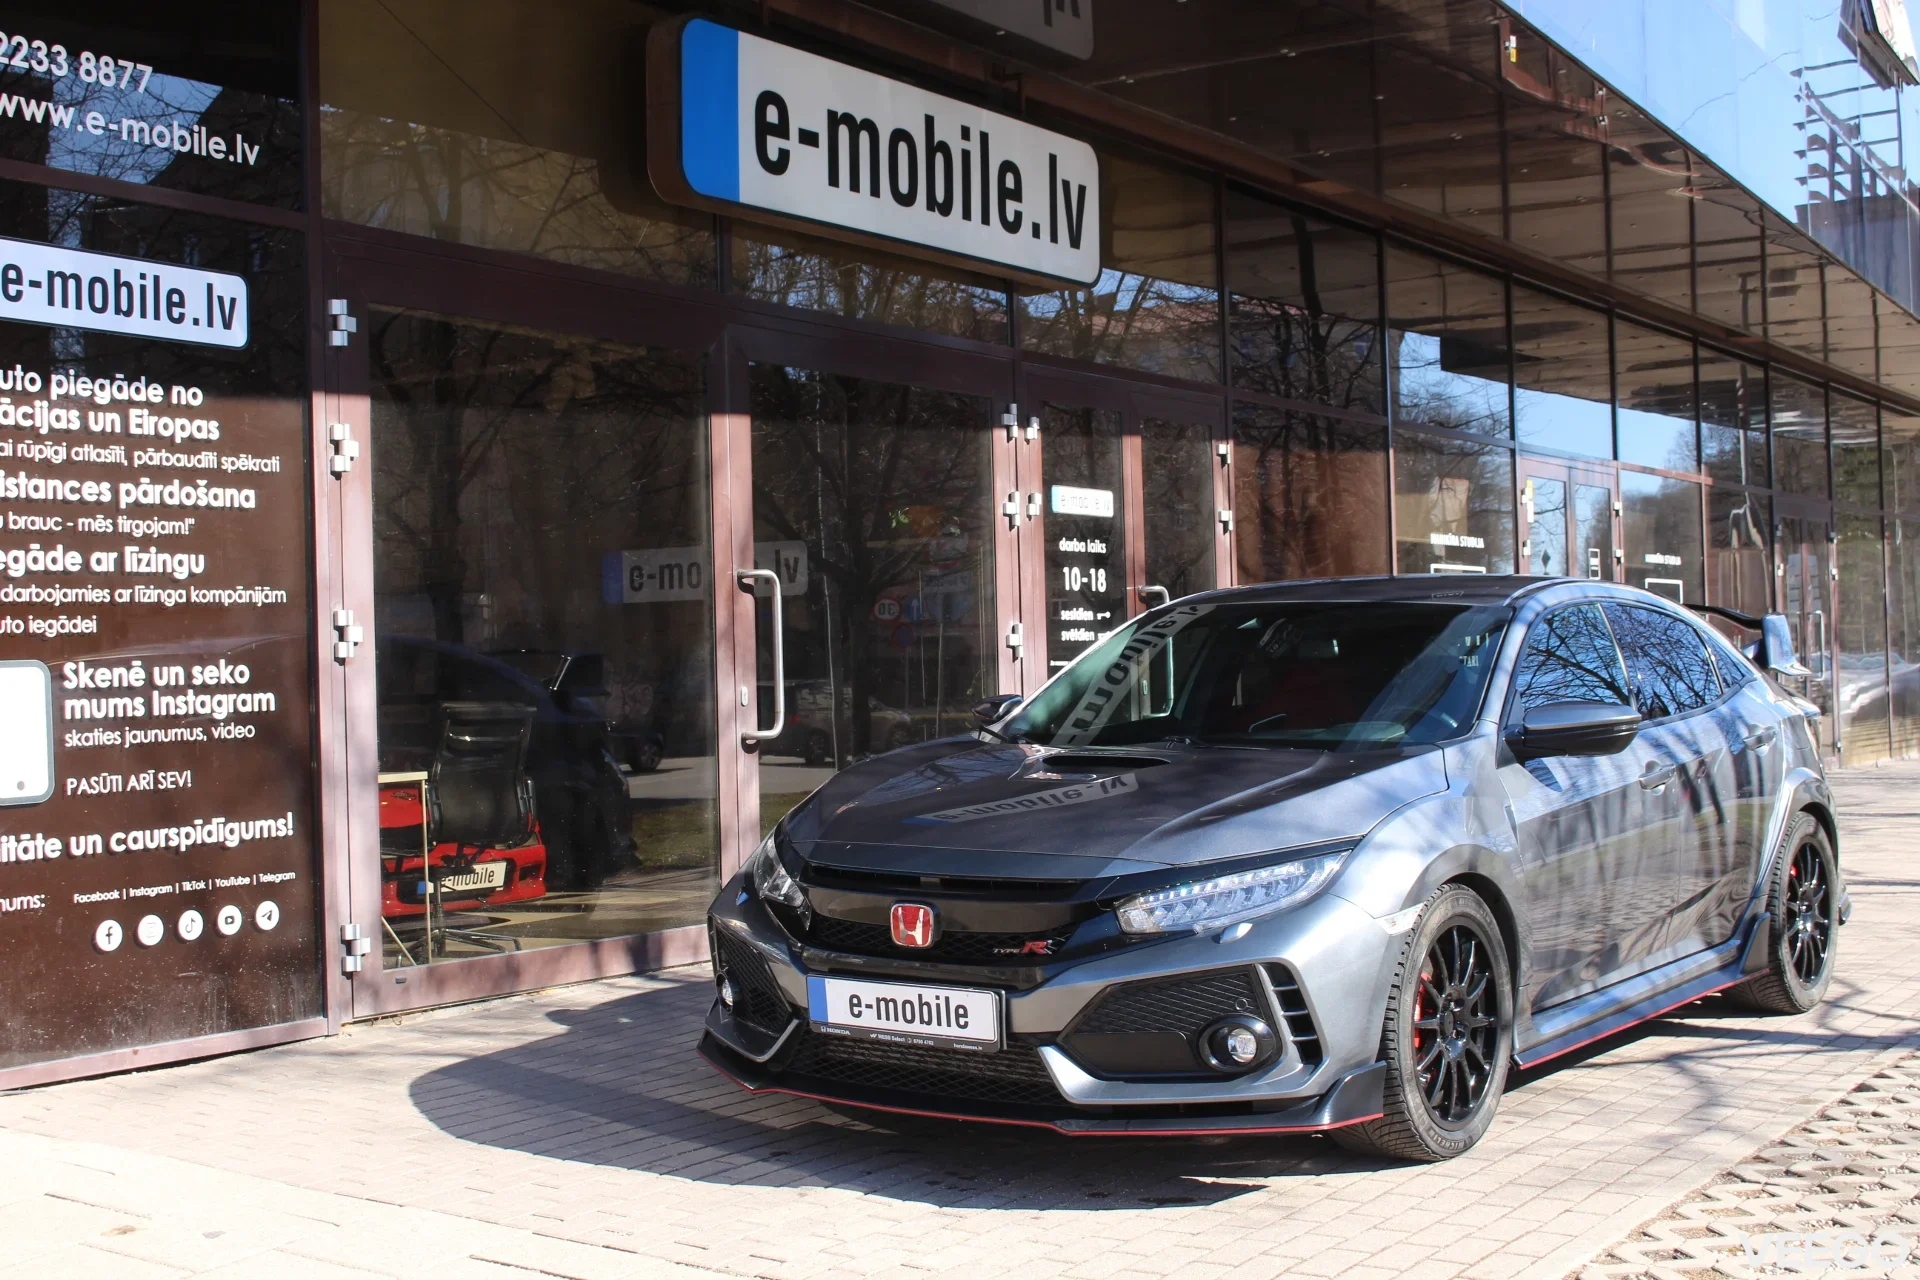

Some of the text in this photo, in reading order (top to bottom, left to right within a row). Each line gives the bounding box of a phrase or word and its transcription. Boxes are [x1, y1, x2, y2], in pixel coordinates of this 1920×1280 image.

[79, 51, 153, 93] 8877
[0, 92, 260, 166] www.e-mobile.lv
[754, 89, 1087, 251] e-mobile.lv
[1, 263, 237, 330] e-mobile.lv
[0, 364, 203, 406] uto piegāde no
[0, 397, 220, 443] ācijas un Eiropas
[17, 440, 67, 465] rūpīgi
[134, 447, 217, 470] pārbaudīti
[221, 453, 280, 475] spēkrati
[119, 477, 256, 509] pārdošana
[9, 511, 62, 533] brauc
[78, 514, 113, 533] mēs
[1059, 536, 1107, 554] darba laiks
[90, 553, 118, 572] ar
[124, 546, 205, 580] līzingu
[1063, 566, 1107, 593] 10-18
[0, 583, 287, 608] darbojamies ar līzinga kompānijām
[28, 615, 97, 638] iegādei
[62, 659, 250, 689] Skenē un seko
[64, 689, 276, 720] mums Instagram
[65, 722, 256, 749] skaties jaunumus, video
[66, 769, 192, 796] PASŪTI ARĪ SEV!
[69, 832, 103, 857] un
[110, 811, 293, 852] caurspīdīgums!
[74, 870, 296, 904] Facebook Instagram TikTok YouTube Telegram
[848, 992, 970, 1030] e-mobile
